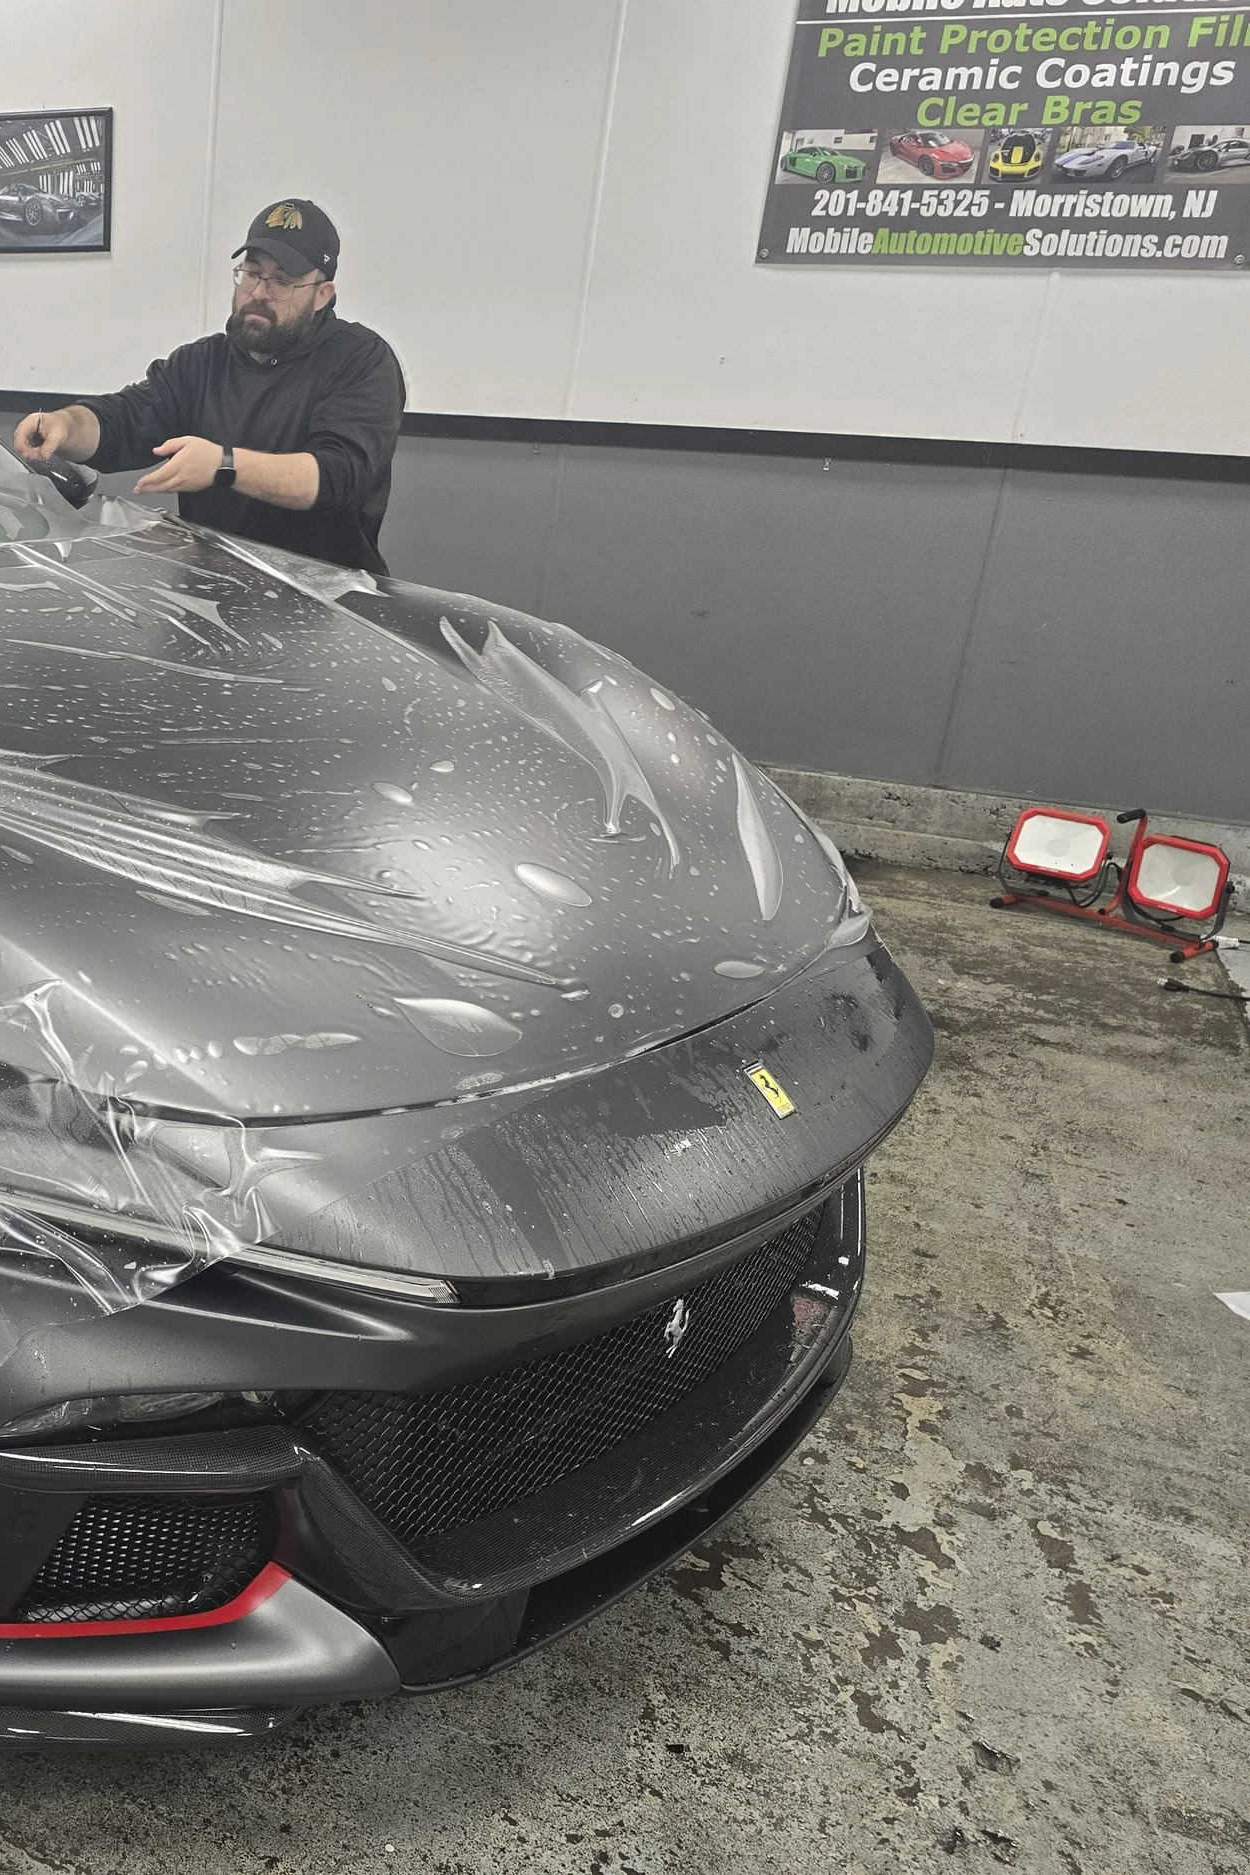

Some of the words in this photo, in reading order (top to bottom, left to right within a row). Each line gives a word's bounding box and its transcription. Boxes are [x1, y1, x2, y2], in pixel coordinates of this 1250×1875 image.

[818, 25, 926, 57] Paint
[939, 18, 1170, 54] Protection
[1187, 14, 1250, 48] Fil
[849, 58, 1022, 92] Ceramic
[1036, 55, 1236, 94] Coatings
[916, 96, 1029, 127] Clear
[1041, 95, 1142, 125] Bras
[811, 189, 990, 217] 201-841-5325
[1009, 190, 1176, 221] Morristown,
[1182, 190, 1218, 218] NJ
[786, 227, 1228, 259] MobileAutomotiveSolutions.com
